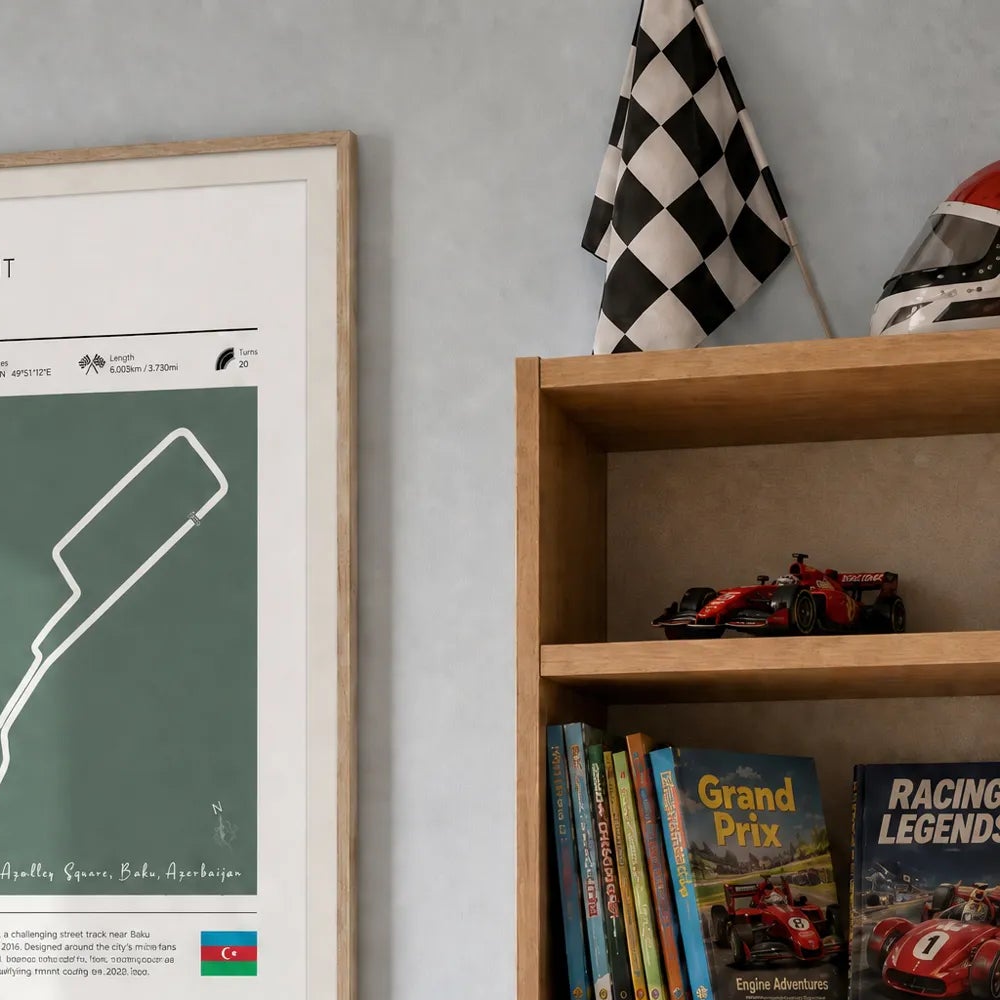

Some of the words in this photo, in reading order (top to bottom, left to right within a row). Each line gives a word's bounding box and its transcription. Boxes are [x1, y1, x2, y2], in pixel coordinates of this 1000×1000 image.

[109, 353, 135, 364] Length
[239, 348, 259, 356] Turns
[148, 363, 179, 372] 3.730mi
[238, 360, 249, 368] 20
[698, 774, 796, 812] Grand
[888, 778, 1000, 810] RACING
[713, 811, 782, 848] Prix
[64, 861, 113, 882] Square,
[118, 862, 160, 882] Baku,
[165, 861, 241, 883] Azerbaijan
[11, 930, 58, 940] challenging
[60, 931, 83, 939] street
[86, 930, 107, 939] track
[130, 930, 150, 939] Baku
[1, 942, 22, 950] 2016.
[25, 942, 62, 952] Designed
[64, 943, 94, 951] around
[96, 942, 109, 951] the
[111, 942, 132, 952] city's
[922, 935, 940, 955] 1
[736, 977, 771, 994] Engine
[773, 977, 829, 991] Adventures
